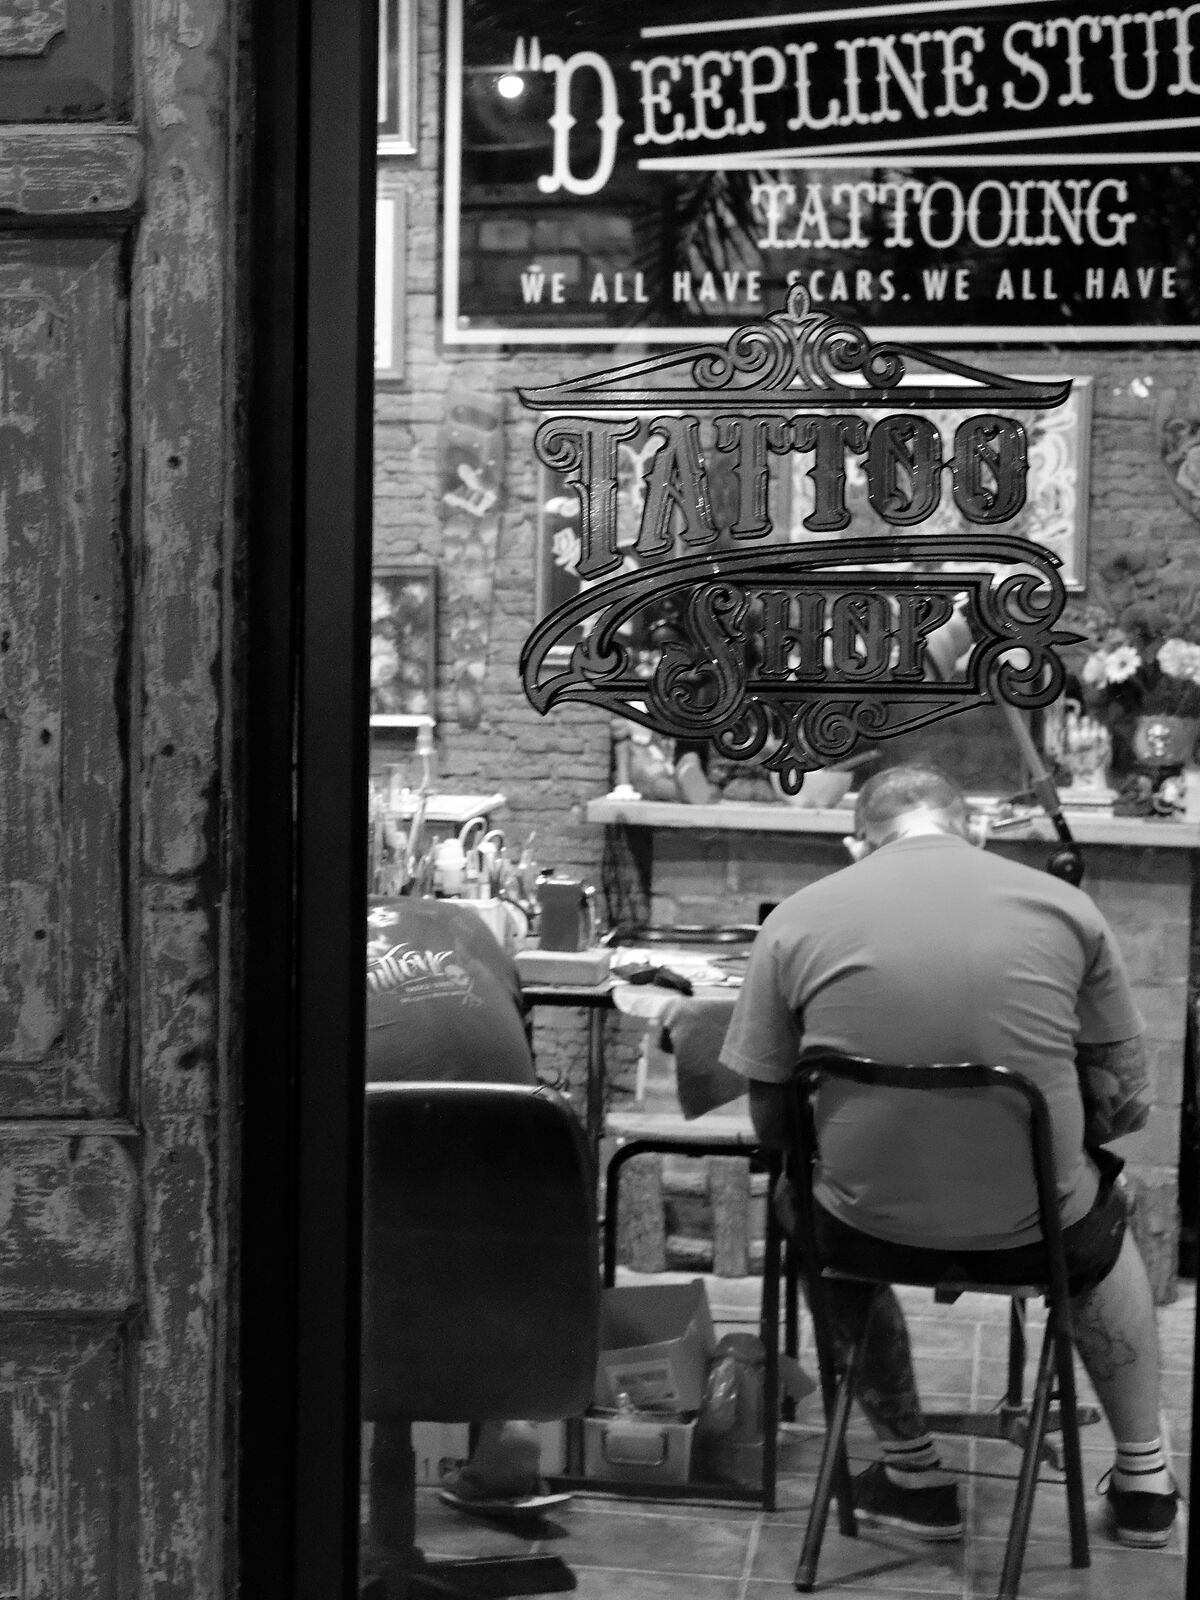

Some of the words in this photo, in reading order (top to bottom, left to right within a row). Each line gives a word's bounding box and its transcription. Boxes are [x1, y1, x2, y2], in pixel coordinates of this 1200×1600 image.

[751, 178, 1136, 250] TATTOOING
[521, 272, 566, 304] WE
[590, 271, 649, 304] ALL
[673, 270, 762, 303] HAVE
[997, 268, 1058, 300] ALL
[1086, 267, 1177, 300] HAVE
[534, 413, 1031, 580] TATTOO
[648, 581, 954, 729] SHOP
